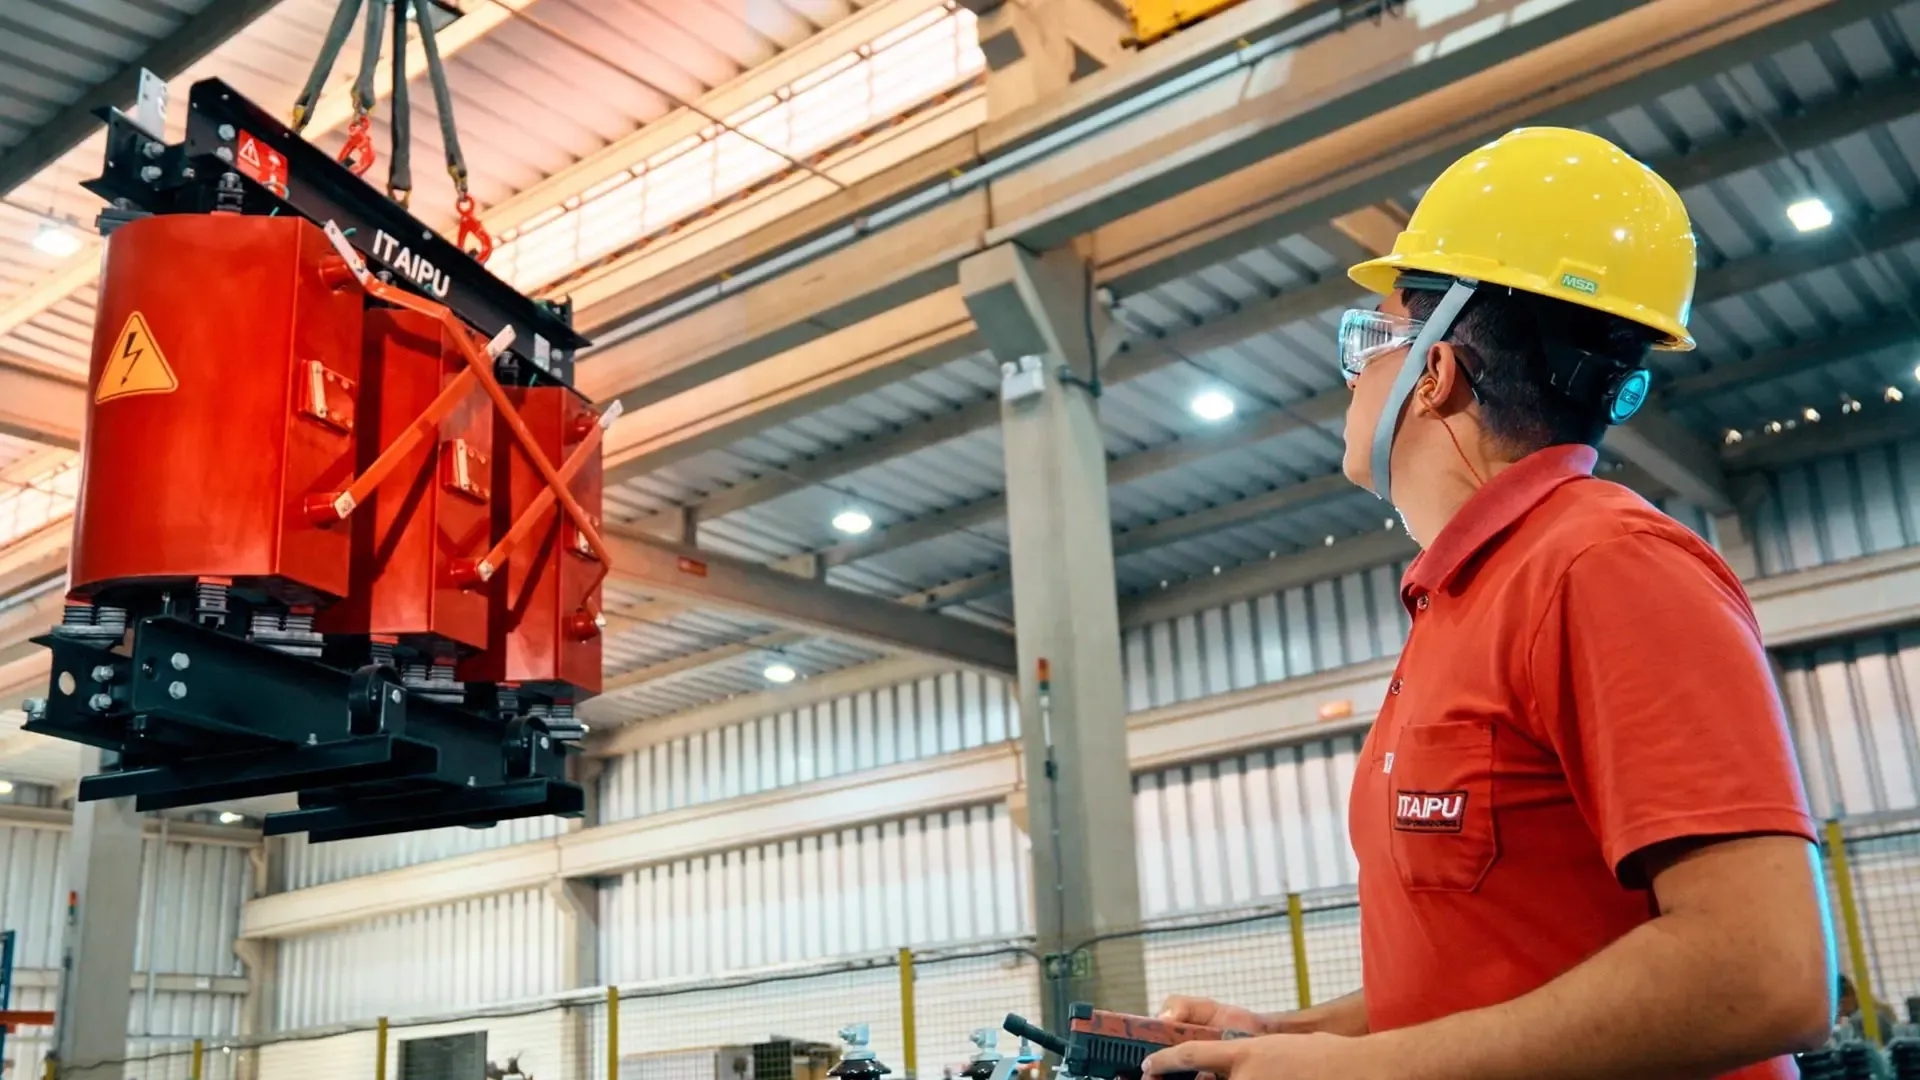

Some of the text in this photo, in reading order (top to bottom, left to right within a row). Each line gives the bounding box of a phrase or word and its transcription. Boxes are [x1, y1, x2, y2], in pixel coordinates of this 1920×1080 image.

[373, 229, 450, 297] ITAIPU
[1562, 275, 1596, 294] MSA
[1397, 796, 1462, 818] ITAIPU
